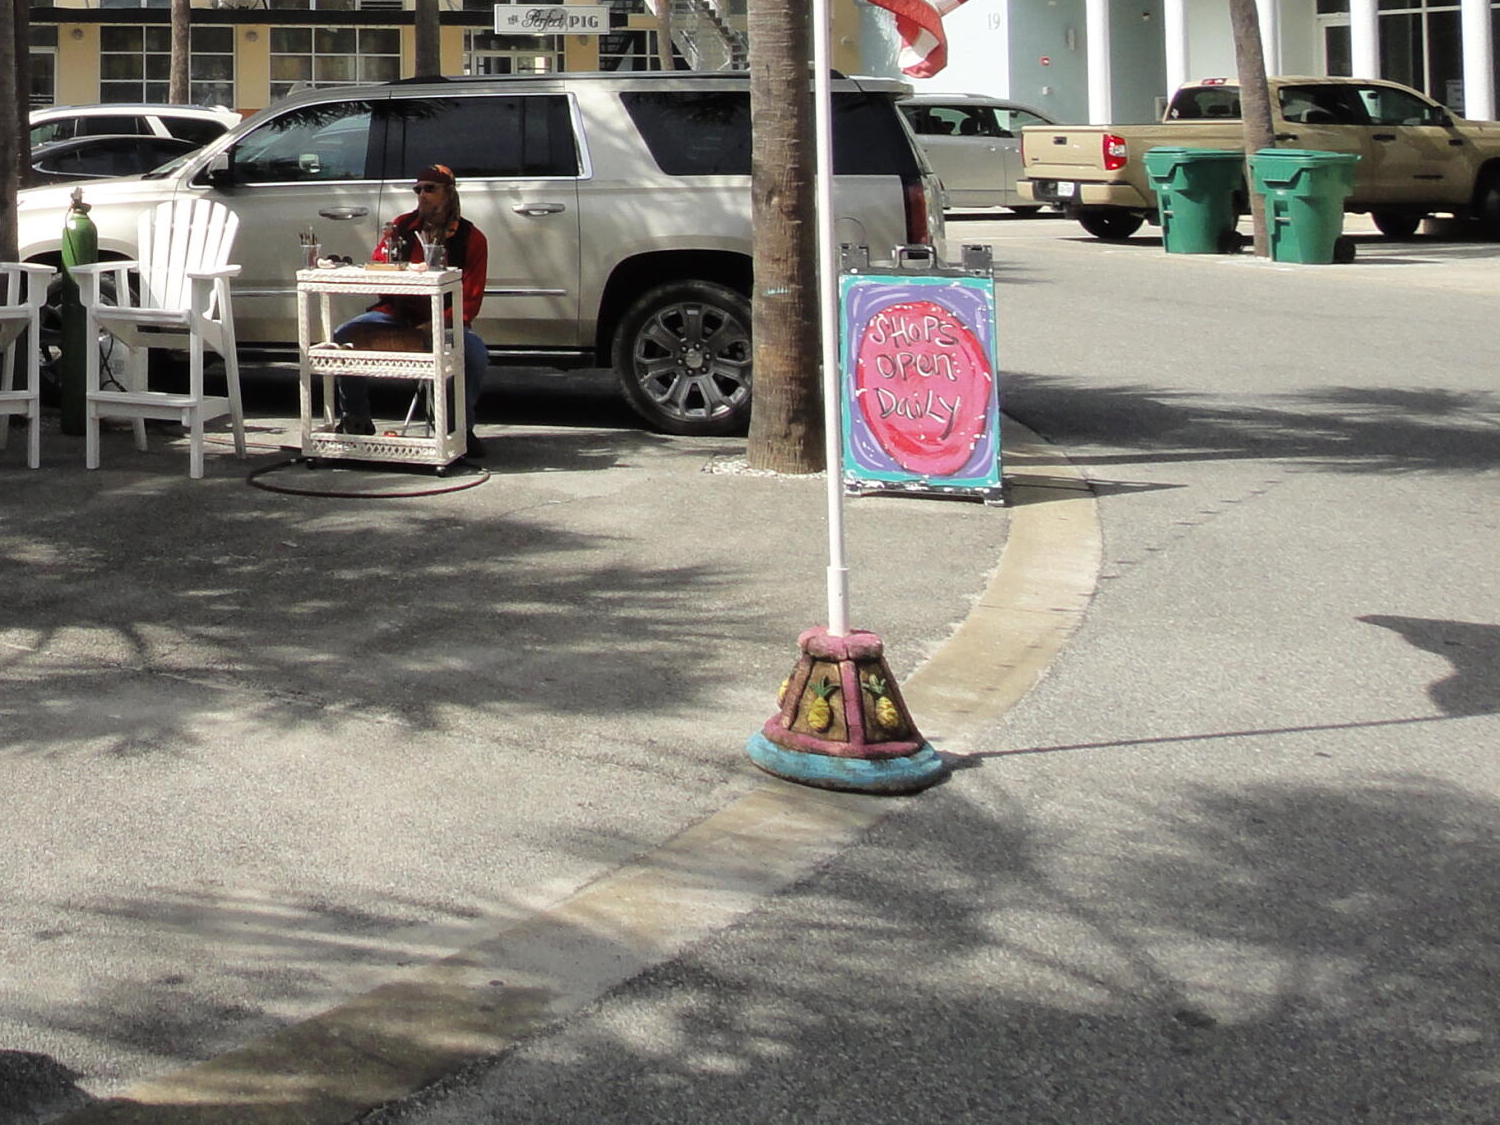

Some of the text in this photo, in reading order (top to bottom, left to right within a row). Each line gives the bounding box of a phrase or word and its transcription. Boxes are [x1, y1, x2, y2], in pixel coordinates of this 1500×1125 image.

[521, 8, 567, 32] Perfect
[568, 15, 599, 28] PIG
[987, 11, 1001, 31] 19
